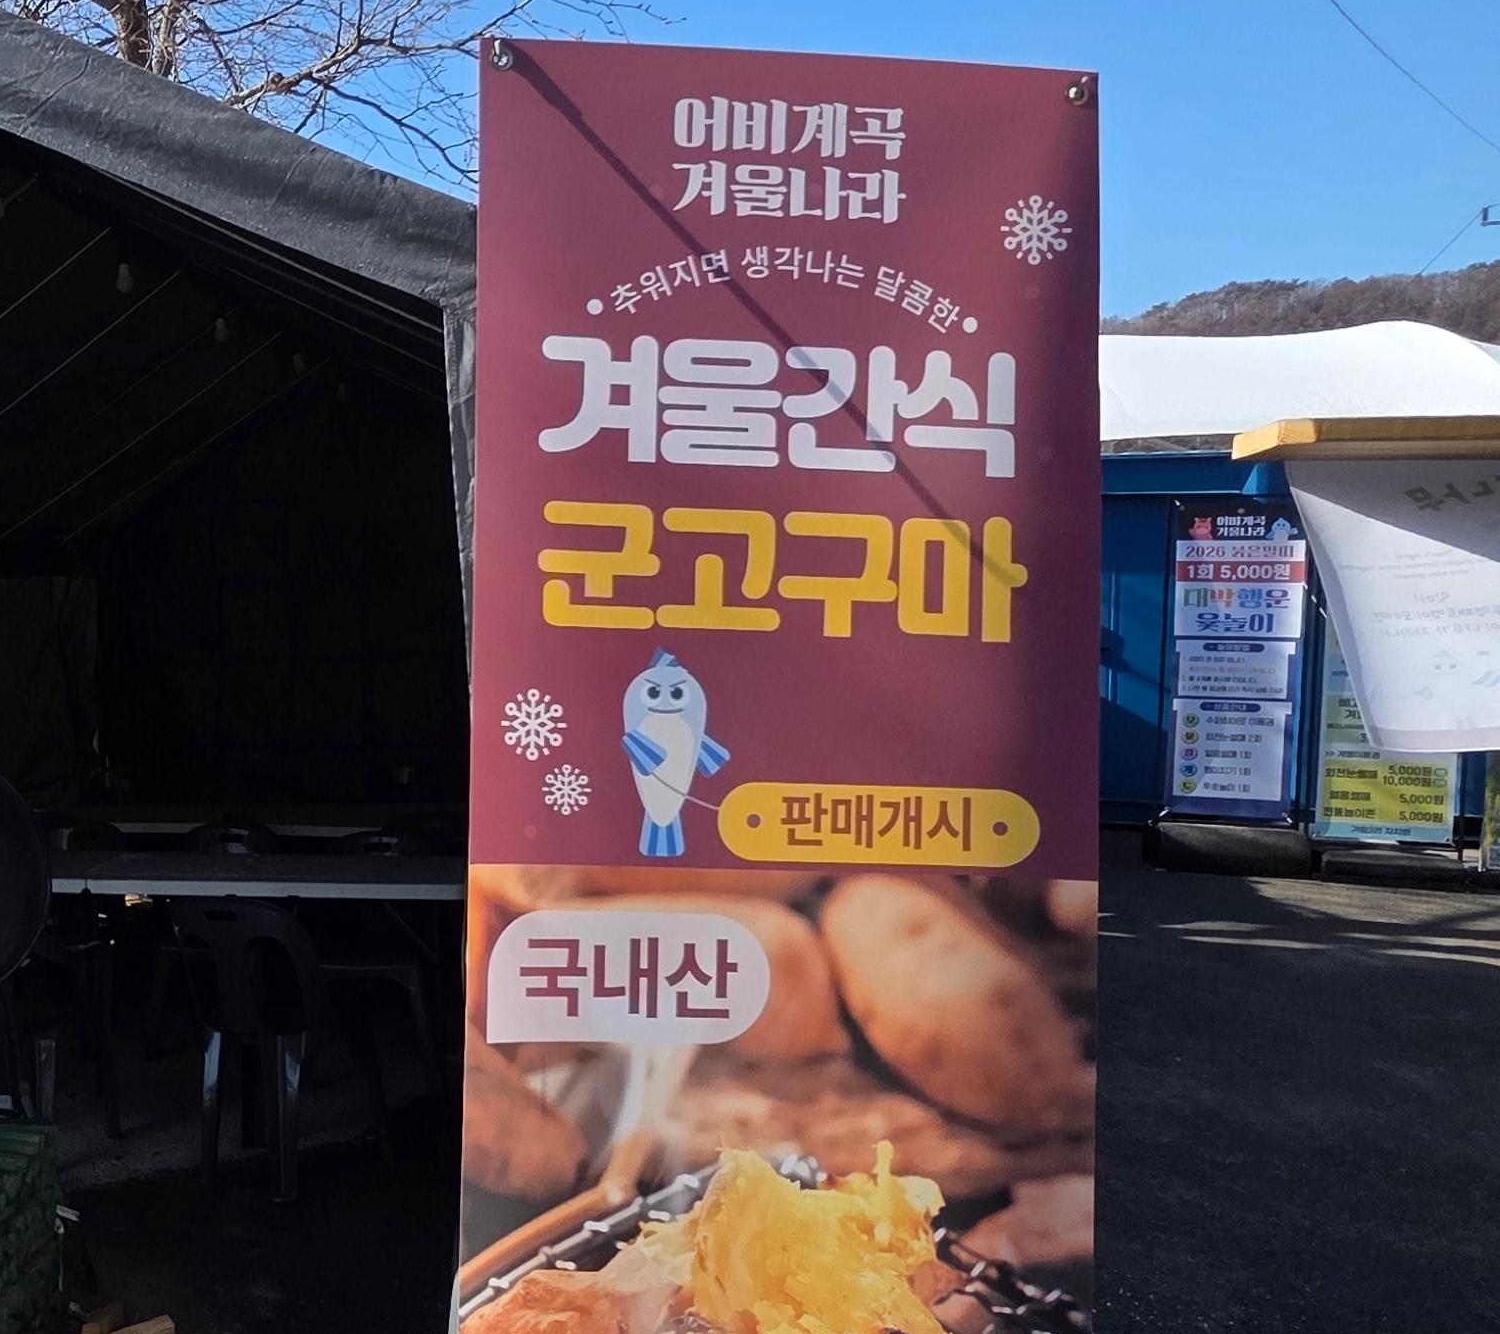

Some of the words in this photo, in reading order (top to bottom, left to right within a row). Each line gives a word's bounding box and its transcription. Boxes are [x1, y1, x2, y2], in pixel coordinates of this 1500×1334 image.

[673, 94, 907, 160] 어비계곡
[671, 160, 907, 225] 겨울나라
[609, 250, 731, 318] 추워지면
[740, 244, 864, 292] 생각나는
[874, 264, 963, 335] 달콤한
[538, 333, 1018, 479] 겨울간식
[1216, 515, 1267, 526] 어비계곡
[1185, 545, 1226, 558] 2026
[538, 499, 1028, 644] 군고구마
[1187, 564, 1215, 580] 1회
[1220, 564, 1291, 580] 5,000원
[1183, 587, 1291, 609] 대박행운
[1383, 776, 1432, 788] 10,000원
[1388, 765, 1432, 777] 5,000원
[1399, 794, 1444, 806] 5,000원
[780, 794, 973, 852] 판매개시
[1399, 810, 1444, 824] 5,000원
[518, 936, 738, 1022] 국내산
